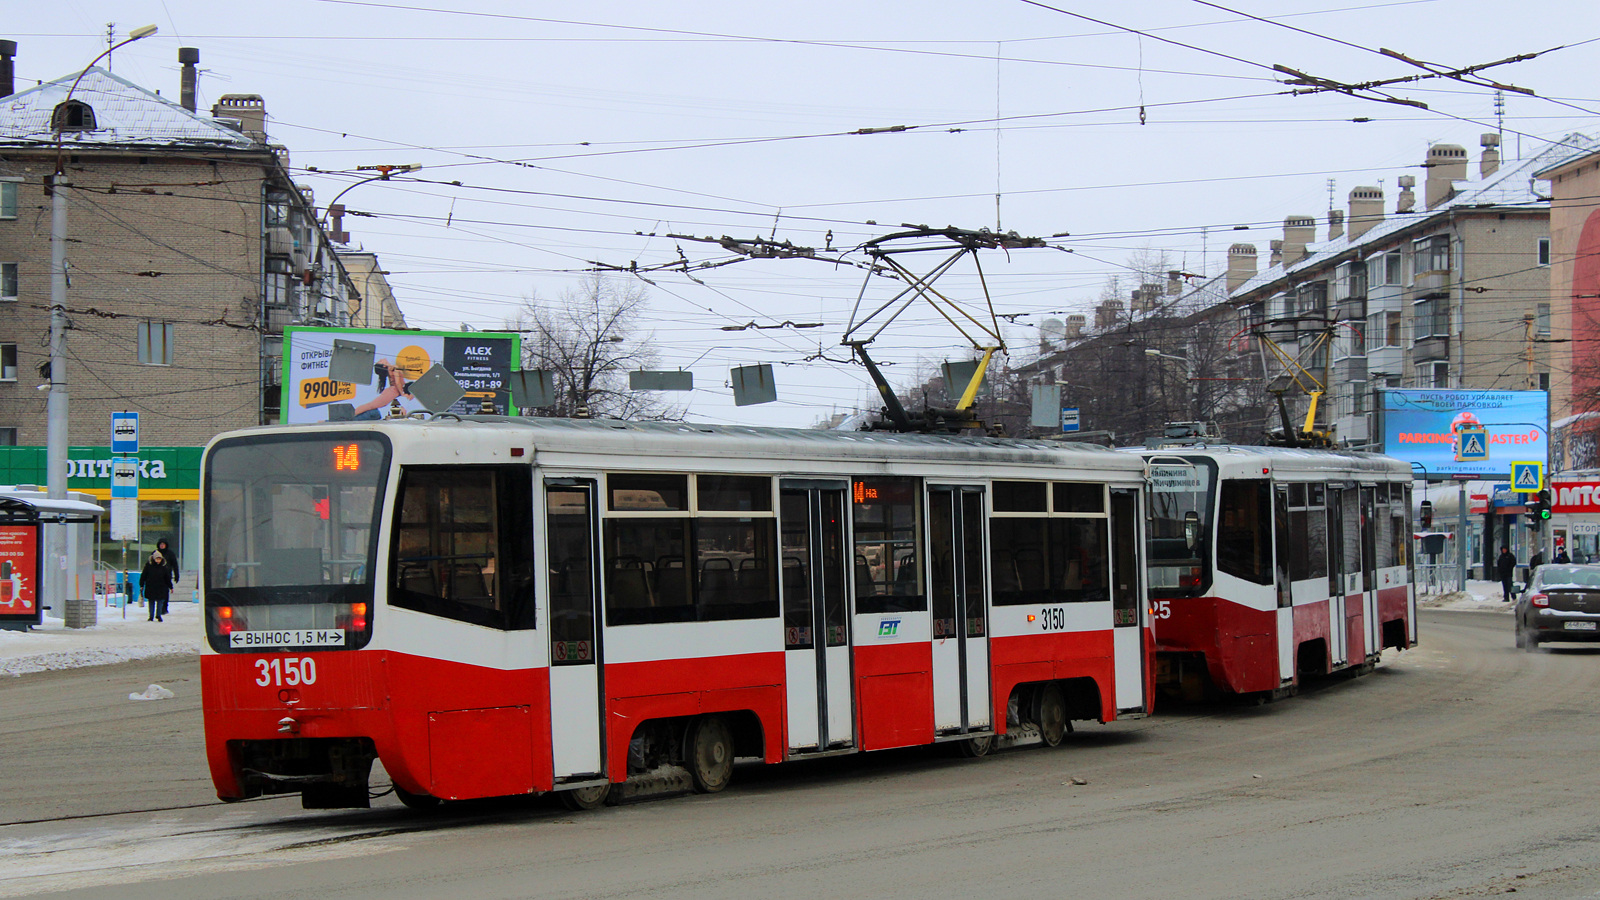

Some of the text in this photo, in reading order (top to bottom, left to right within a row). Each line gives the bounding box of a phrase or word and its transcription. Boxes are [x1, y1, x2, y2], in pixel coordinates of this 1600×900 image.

[464, 346, 492, 356] ALEX
[301, 361, 329, 370] ФИТНЕС
[304, 381, 337, 399] 9900
[338, 387, 352, 395] РУБ.
[1457, 401, 1503, 409] ПАРКОВКОЙ
[1399, 433, 1453, 444] PARKING
[333, 444, 360, 471] 14
[1574, 525, 1597, 533] СТОП
[1041, 608, 1065, 631] 3150
[245, 631, 327, 645] ВЫНОС 1,5 М
[254, 656, 317, 687] 3150
